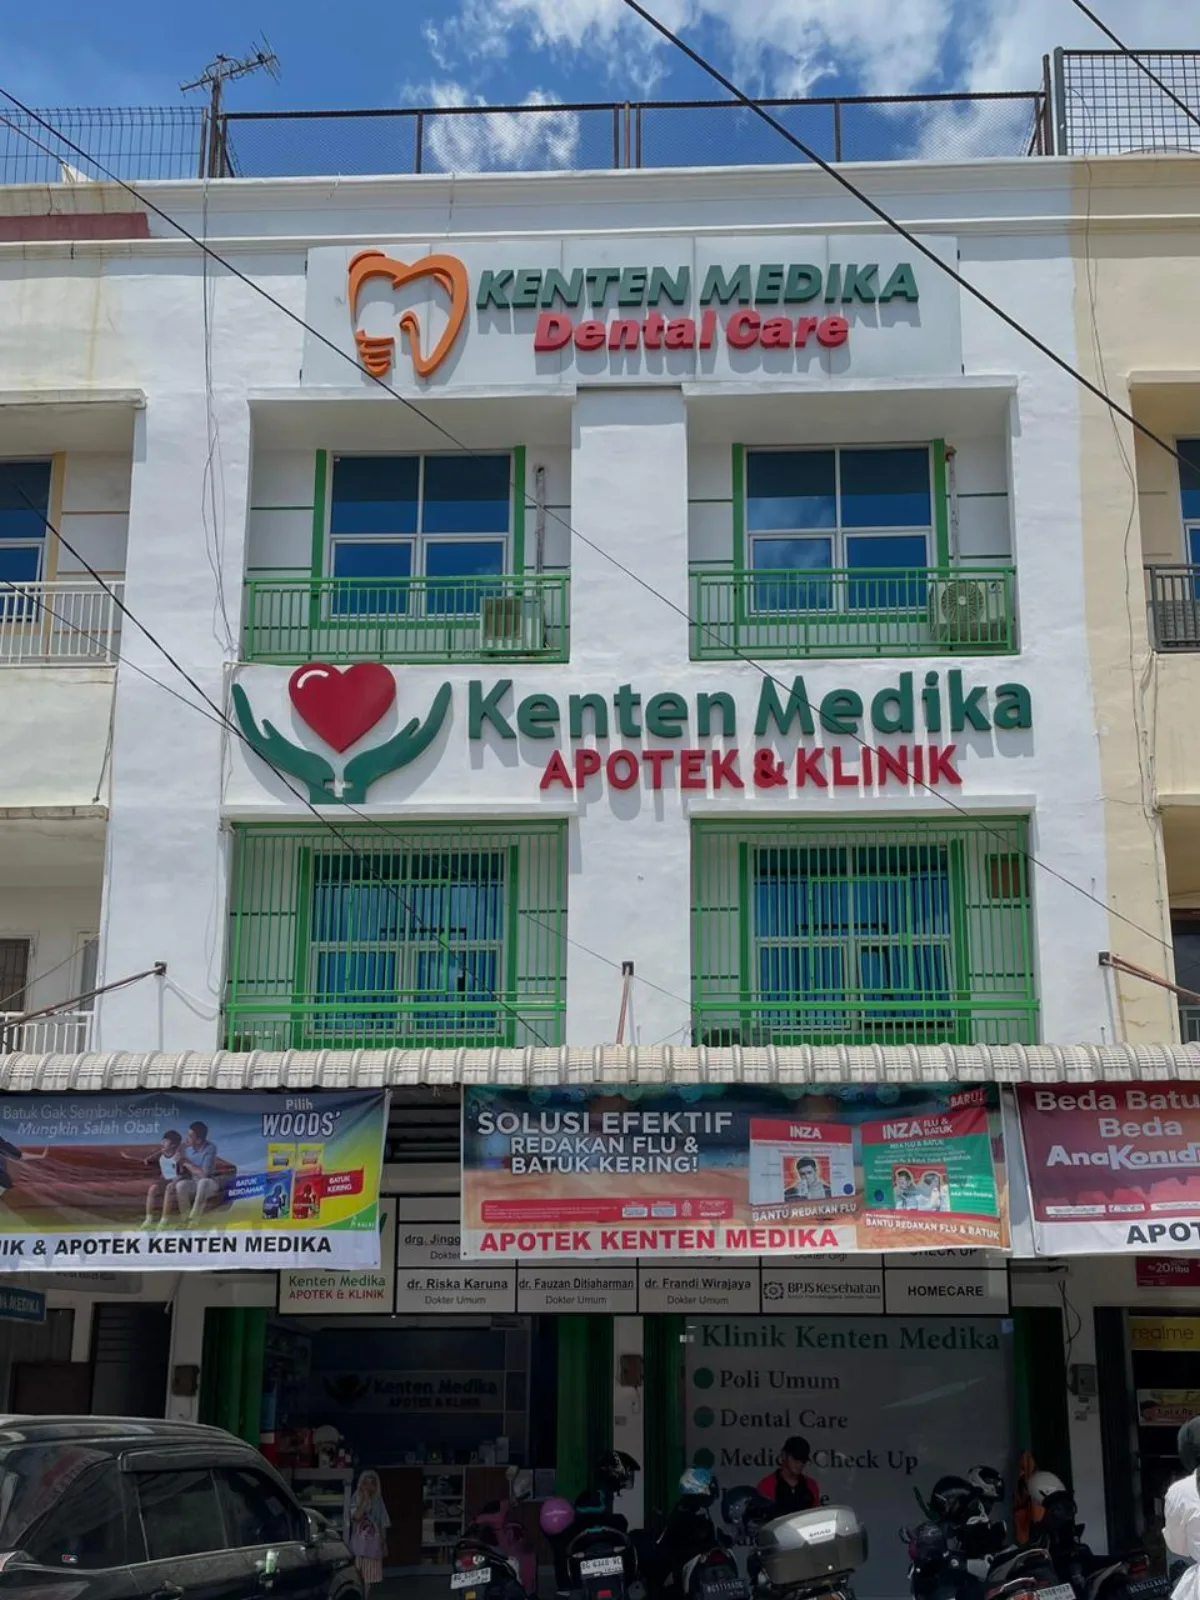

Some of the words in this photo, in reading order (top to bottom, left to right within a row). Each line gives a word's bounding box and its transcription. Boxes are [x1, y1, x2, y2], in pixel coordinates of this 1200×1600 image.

[476, 266, 690, 309] KENTEN
[700, 263, 920, 304] MEDIKA
[534, 310, 715, 352] Dental
[726, 308, 849, 350] Care
[468, 678, 735, 740] Kenten
[754, 669, 1033, 737] Medika
[540, 748, 744, 790] APOTEK
[795, 745, 962, 788] KLINIK
[285, 1098, 313, 1111] Pilih
[1035, 1090, 1116, 1111] Beda
[1126, 1090, 1200, 1110] Batu
[2, 1104, 38, 1120] Batuk
[40, 1104, 67, 1120] Gak
[17, 1122, 78, 1139] Mungkin
[82, 1120, 119, 1136] Salah
[124, 1119, 161, 1135] Obat
[477, 1111, 589, 1135] SOLUSI
[602, 1111, 732, 1134] EFEKTIF
[882, 1120, 924, 1140] INZA
[923, 1118, 938, 1127] FLU
[941, 1117, 949, 1125] &
[924, 1124, 953, 1136] BATUK
[1098, 1116, 1183, 1138] Beda
[789, 1125, 822, 1140] INZA
[510, 1136, 625, 1155] REDAKAN
[633, 1136, 676, 1153] FLU
[684, 1137, 699, 1153] &
[1046, 1142, 1200, 1170] AnaKonid
[511, 1156, 590, 1175] BATUK
[600, 1156, 698, 1174] KERING!
[235, 1178, 258, 1187] BATUK
[327, 1184, 353, 1193] KERING
[328, 1175, 351, 1185] BATUK
[752, 1210, 789, 1222] BANTU
[791, 1205, 839, 1218] REDAKAN
[840, 1203, 857, 1213] FLU
[865, 1217, 895, 1228] BANTU
[895, 1220, 938, 1232] REDAKAN
[940, 1223, 957, 1234] FLU
[959, 1226, 965, 1234] &
[967, 1226, 1000, 1240] BATUK
[0, 1239, 26, 1256] IK
[32, 1239, 47, 1256] &
[55, 1239, 141, 1256] APOTEK
[148, 1237, 238, 1255] KENTEN
[244, 1236, 332, 1254] MEDIKA
[405, 1234, 426, 1246] drg.
[480, 1231, 592, 1251] APOTEK
[601, 1229, 715, 1250] KENTEN
[726, 1228, 839, 1249] MEDIKA
[289, 1275, 335, 1287] Kenten
[340, 1274, 386, 1286] Medika
[407, 1279, 423, 1290] dr.
[426, 1278, 460, 1290] Riska
[464, 1279, 508, 1290] Karuna
[518, 1278, 531, 1289] dr.
[534, 1278, 570, 1289] Fauzan
[644, 1278, 659, 1289] dr.
[663, 1278, 698, 1289] Frandi
[701, 1278, 751, 1291] Wirajaya
[788, 1282, 814, 1294] BPJS
[816, 1281, 880, 1294] Kesehatan
[289, 1289, 332, 1300] APOTEK
[337, 1289, 345, 1299] &
[349, 1289, 385, 1299] KLINIK
[907, 1285, 984, 1297] HOMECARE
[425, 1295, 455, 1305] Dokter
[457, 1295, 486, 1305] Umum
[546, 1295, 575, 1305] Dokter
[577, 1295, 607, 1305] Umum
[667, 1296, 697, 1305] Dokter
[699, 1296, 729, 1305] Umum
[701, 1324, 786, 1348] Klinik
[795, 1325, 889, 1349] Kenten
[900, 1325, 999, 1350] Medika
[1131, 1325, 1195, 1341] realme
[374, 1378, 433, 1394] Kenten
[438, 1377, 497, 1394] Medika
[720, 1370, 760, 1389] Poli
[768, 1371, 841, 1390] Umum
[720, 1408, 790, 1428] Dental
[799, 1408, 849, 1429] Care
[720, 1447, 782, 1468] Medic
[812, 1447, 880, 1470] Check
[886, 1450, 919, 1475] Up
